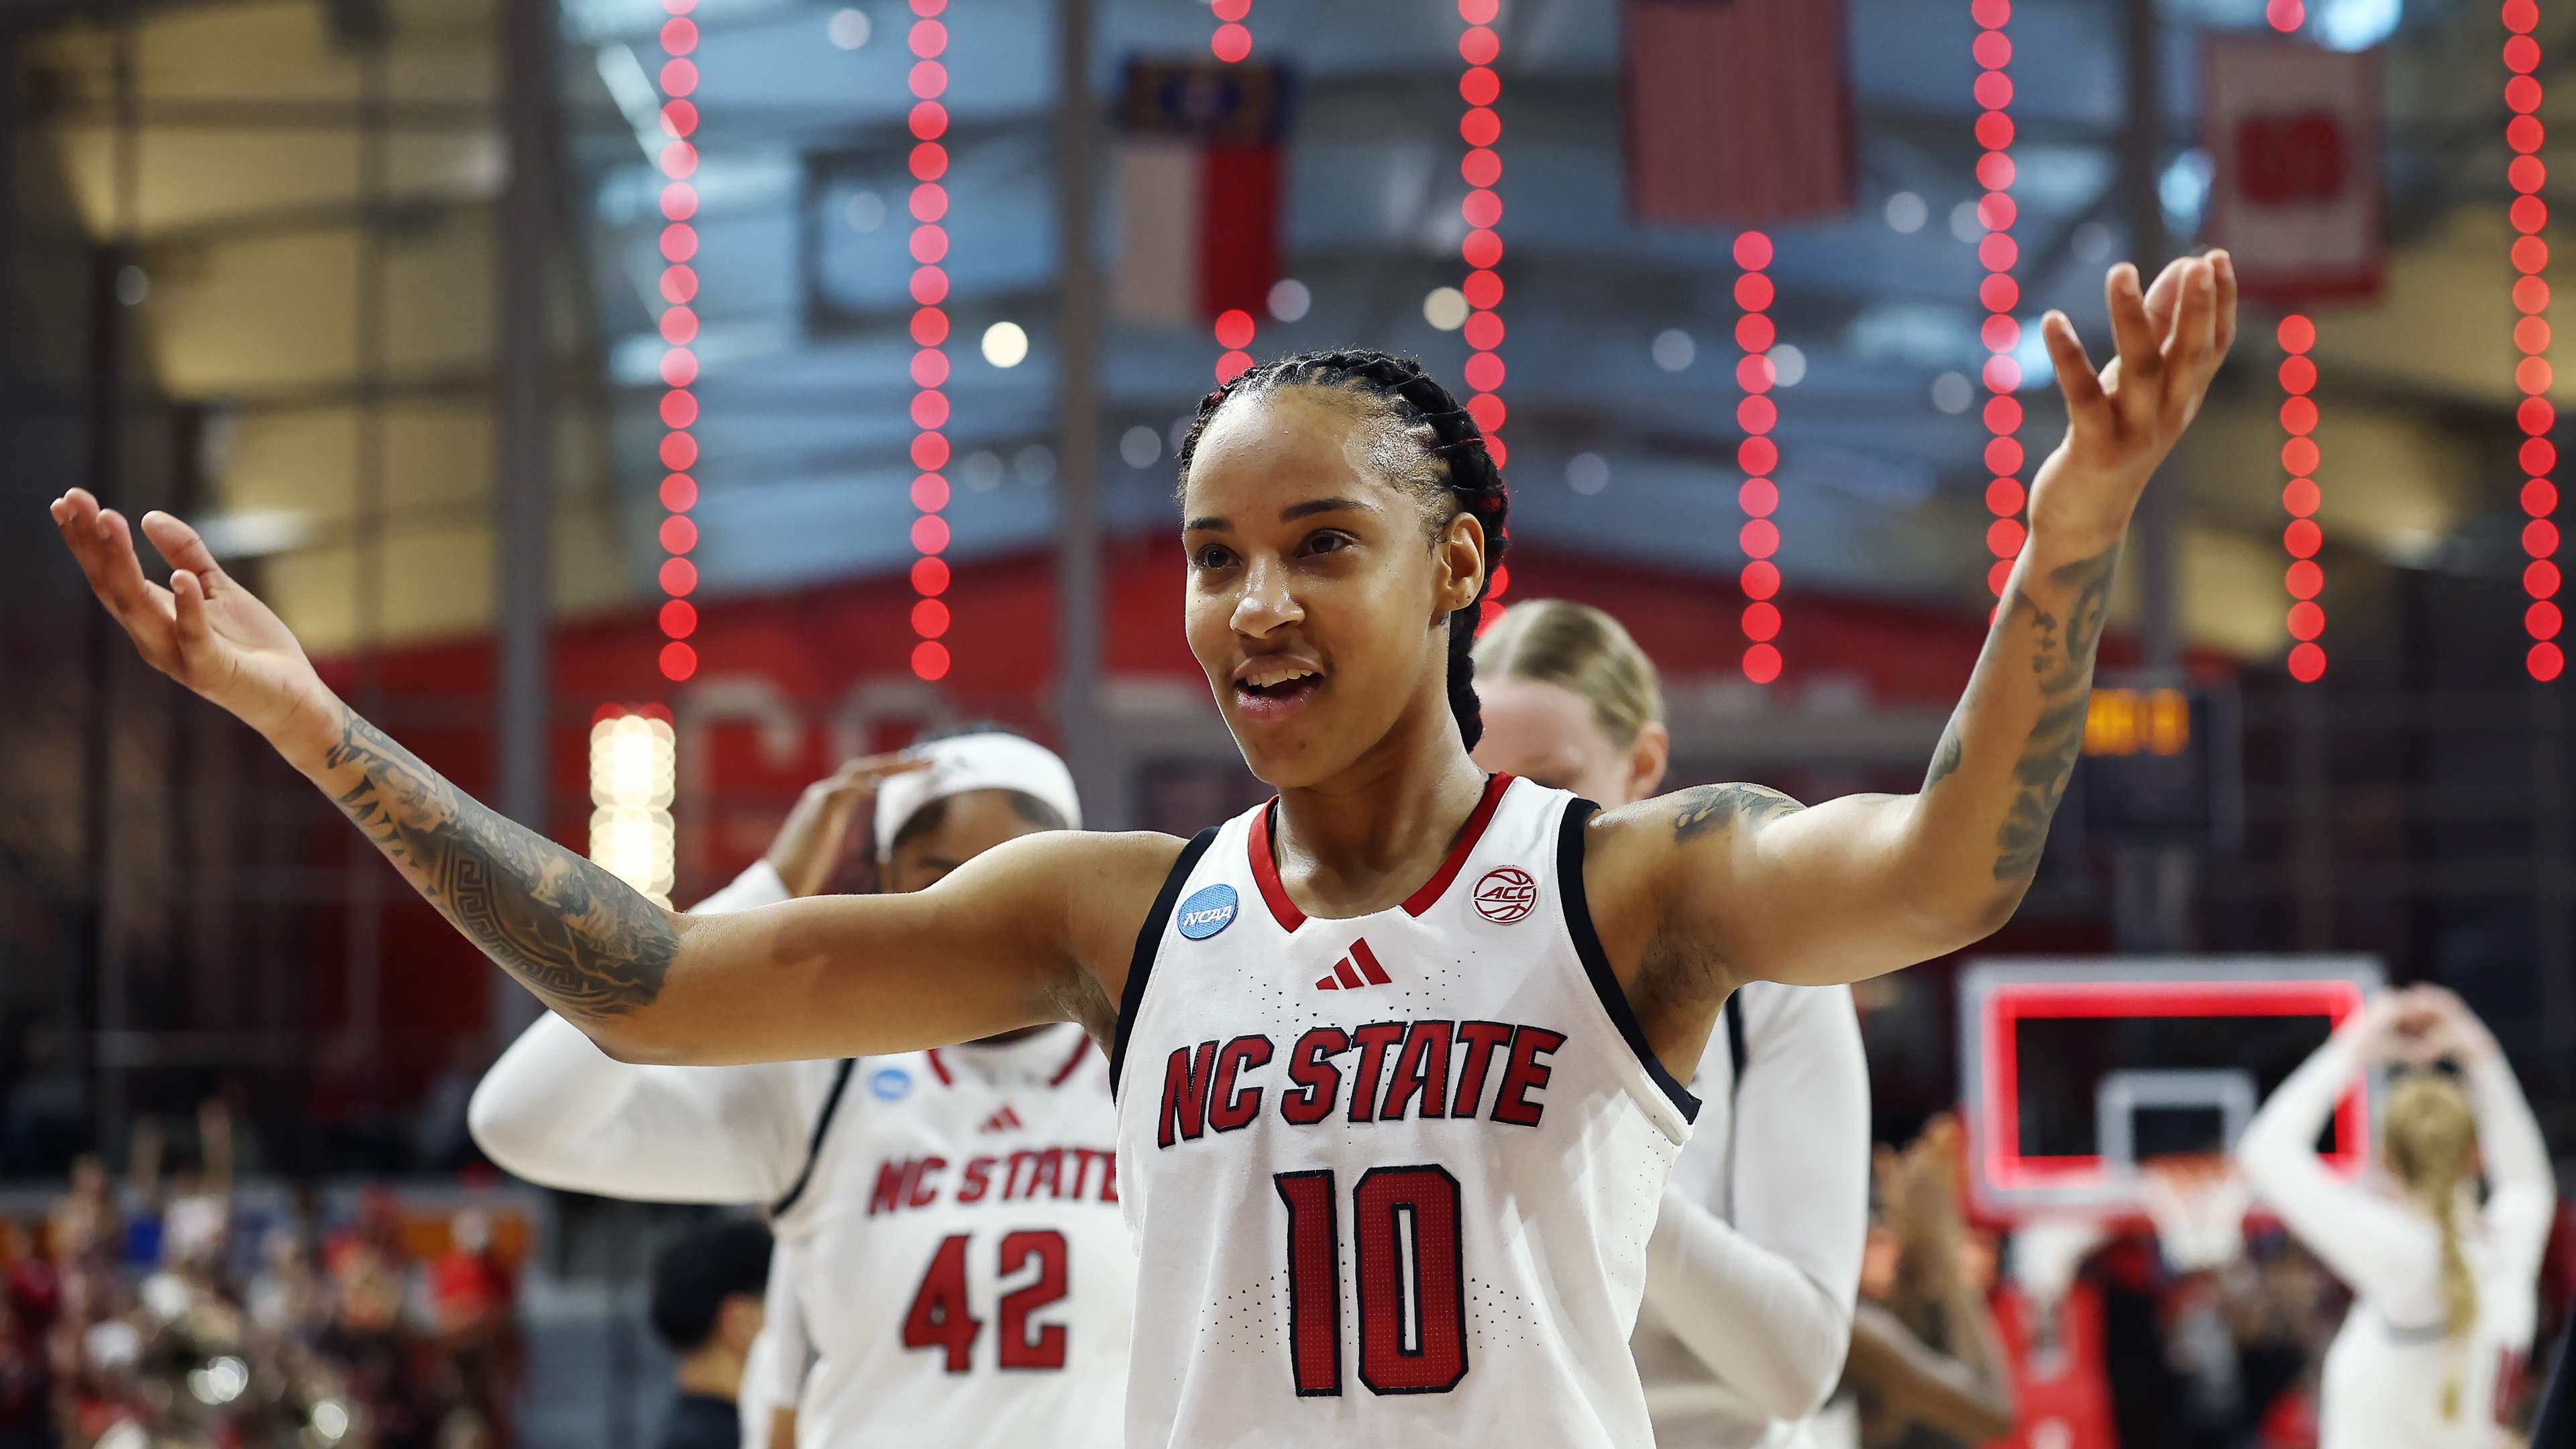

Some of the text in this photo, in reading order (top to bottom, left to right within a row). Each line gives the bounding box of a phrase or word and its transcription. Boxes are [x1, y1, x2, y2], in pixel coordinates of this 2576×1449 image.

[1183, 906, 1232, 928] NCAA
[1480, 885, 1535, 900] ACC
[1157, 1020, 1568, 1149] NC STATE
[867, 1155, 947, 1216] NC
[900, 1230, 1069, 1373] 42
[1273, 1163, 1469, 1397] 10
